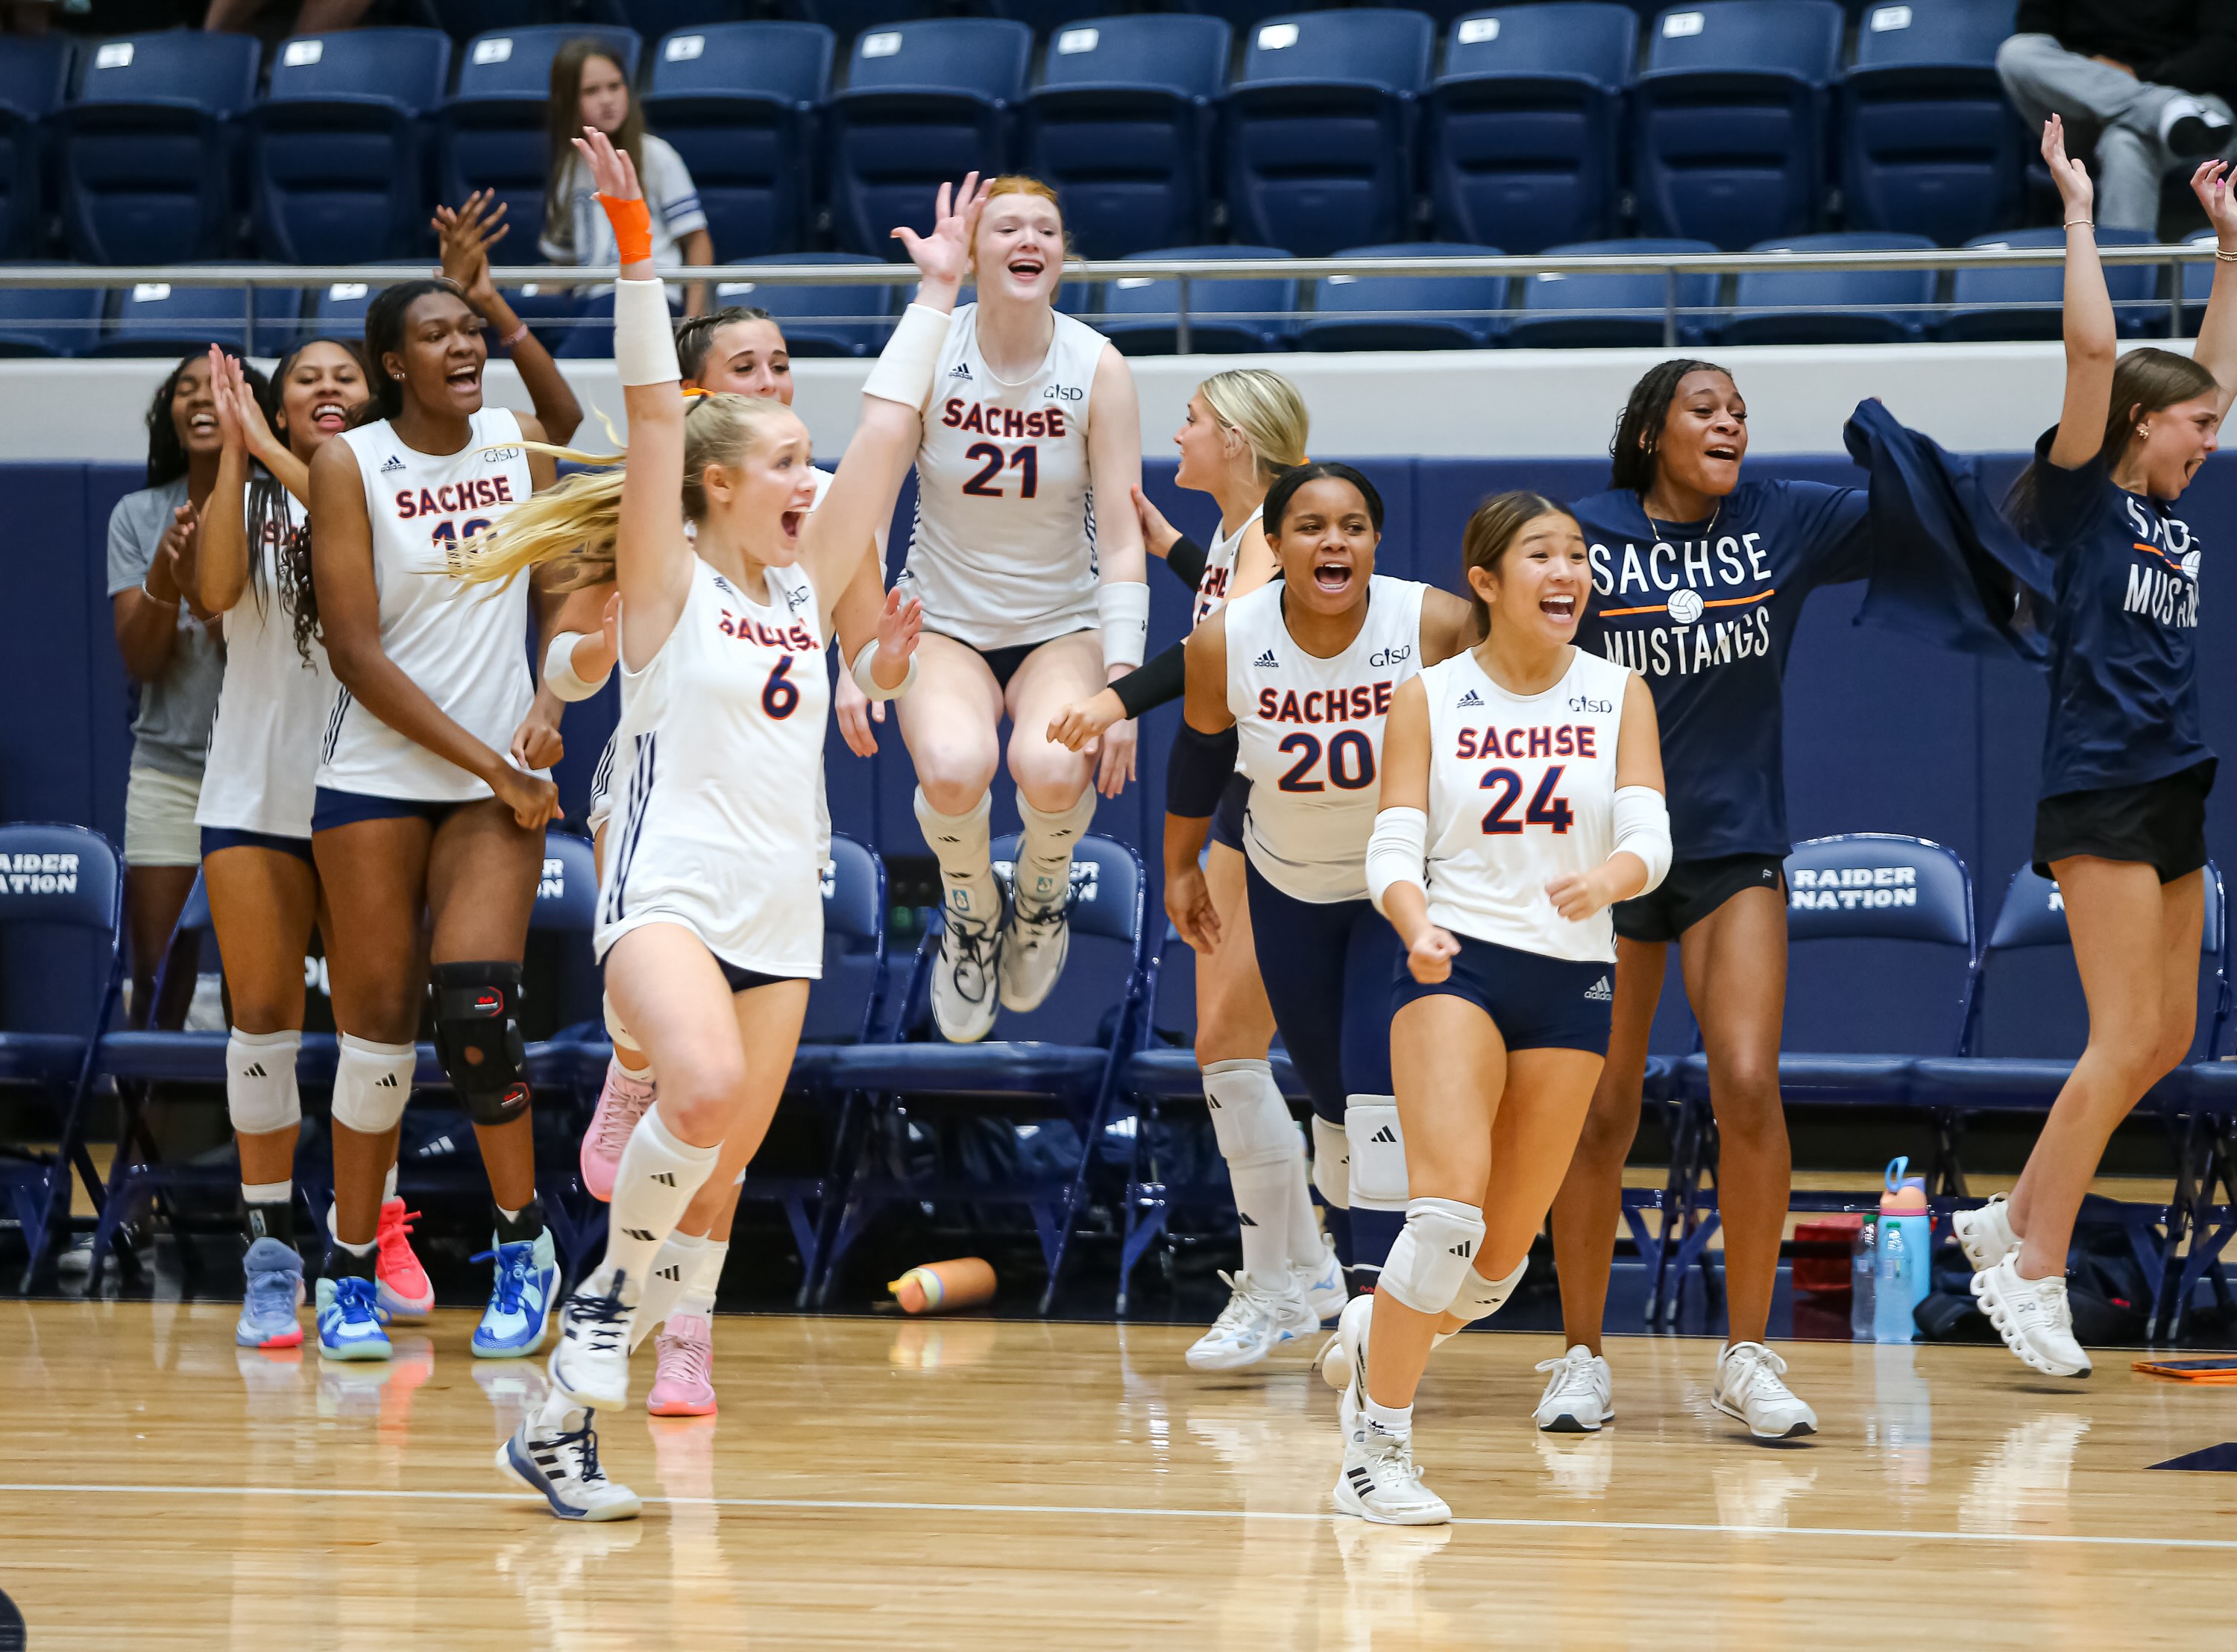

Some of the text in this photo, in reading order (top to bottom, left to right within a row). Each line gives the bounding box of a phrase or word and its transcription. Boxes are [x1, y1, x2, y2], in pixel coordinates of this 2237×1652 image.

[948, 372, 973, 380] adidas
[1044, 384, 1083, 400] GISD
[942, 397, 1066, 438] SACHSE
[963, 441, 1038, 499] 21
[395, 474, 514, 519] SACHSE
[1588, 532, 1772, 596] SACHSE
[1370, 645, 1411, 667] GISD
[1603, 605, 1770, 676] MUSTANGS
[1253, 660, 1280, 668] adidas
[761, 654, 800, 721] 6
[1257, 680, 1393, 724] SACHSE
[1456, 699, 1485, 708] adidas
[1569, 695, 1613, 713] GISD
[1277, 728, 1377, 793] 20
[1456, 723, 1597, 760] SACHSE
[1479, 764, 1575, 835] 24
[1793, 866, 1917, 888] RAIDER
[1791, 887, 1917, 909] NATION
